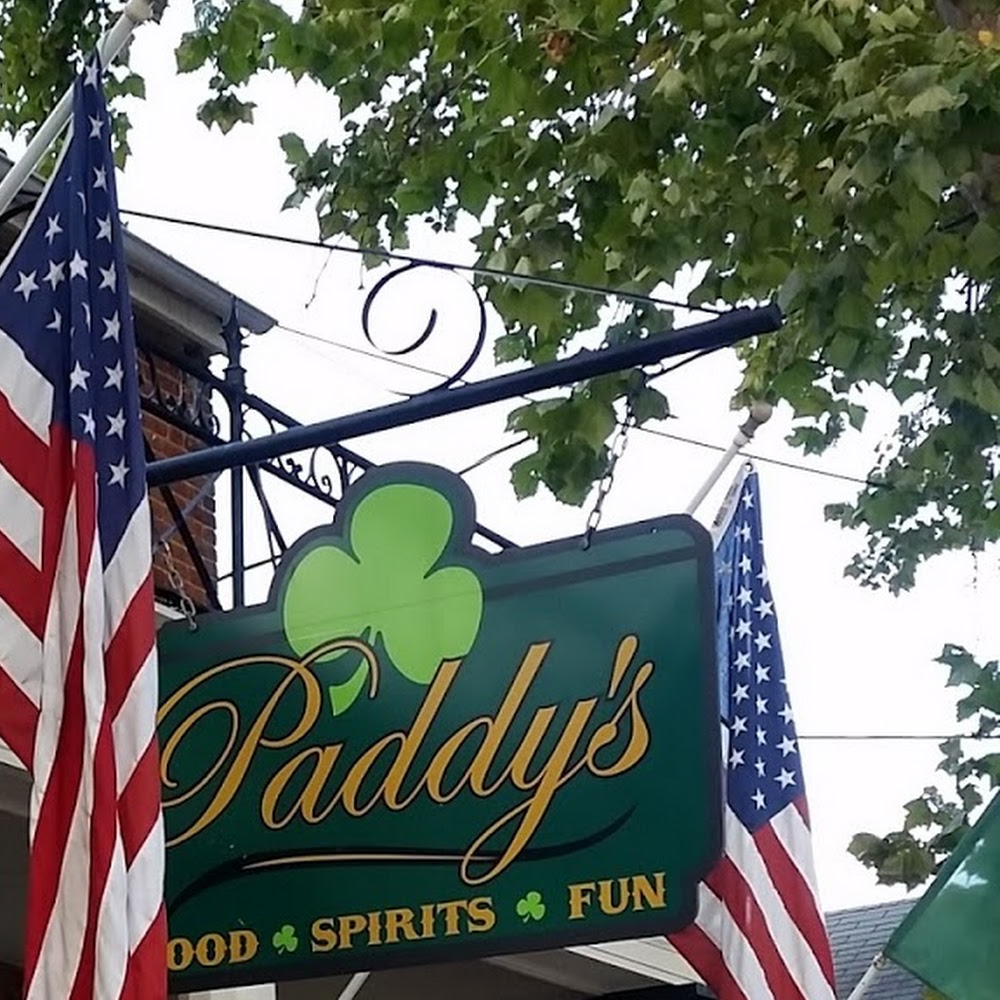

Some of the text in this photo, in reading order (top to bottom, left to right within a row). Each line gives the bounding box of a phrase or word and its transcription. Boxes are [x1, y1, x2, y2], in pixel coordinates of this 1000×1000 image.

[156, 634, 654, 885] Paddy's
[166, 871, 667, 971] OOD SPIRITS FUN
